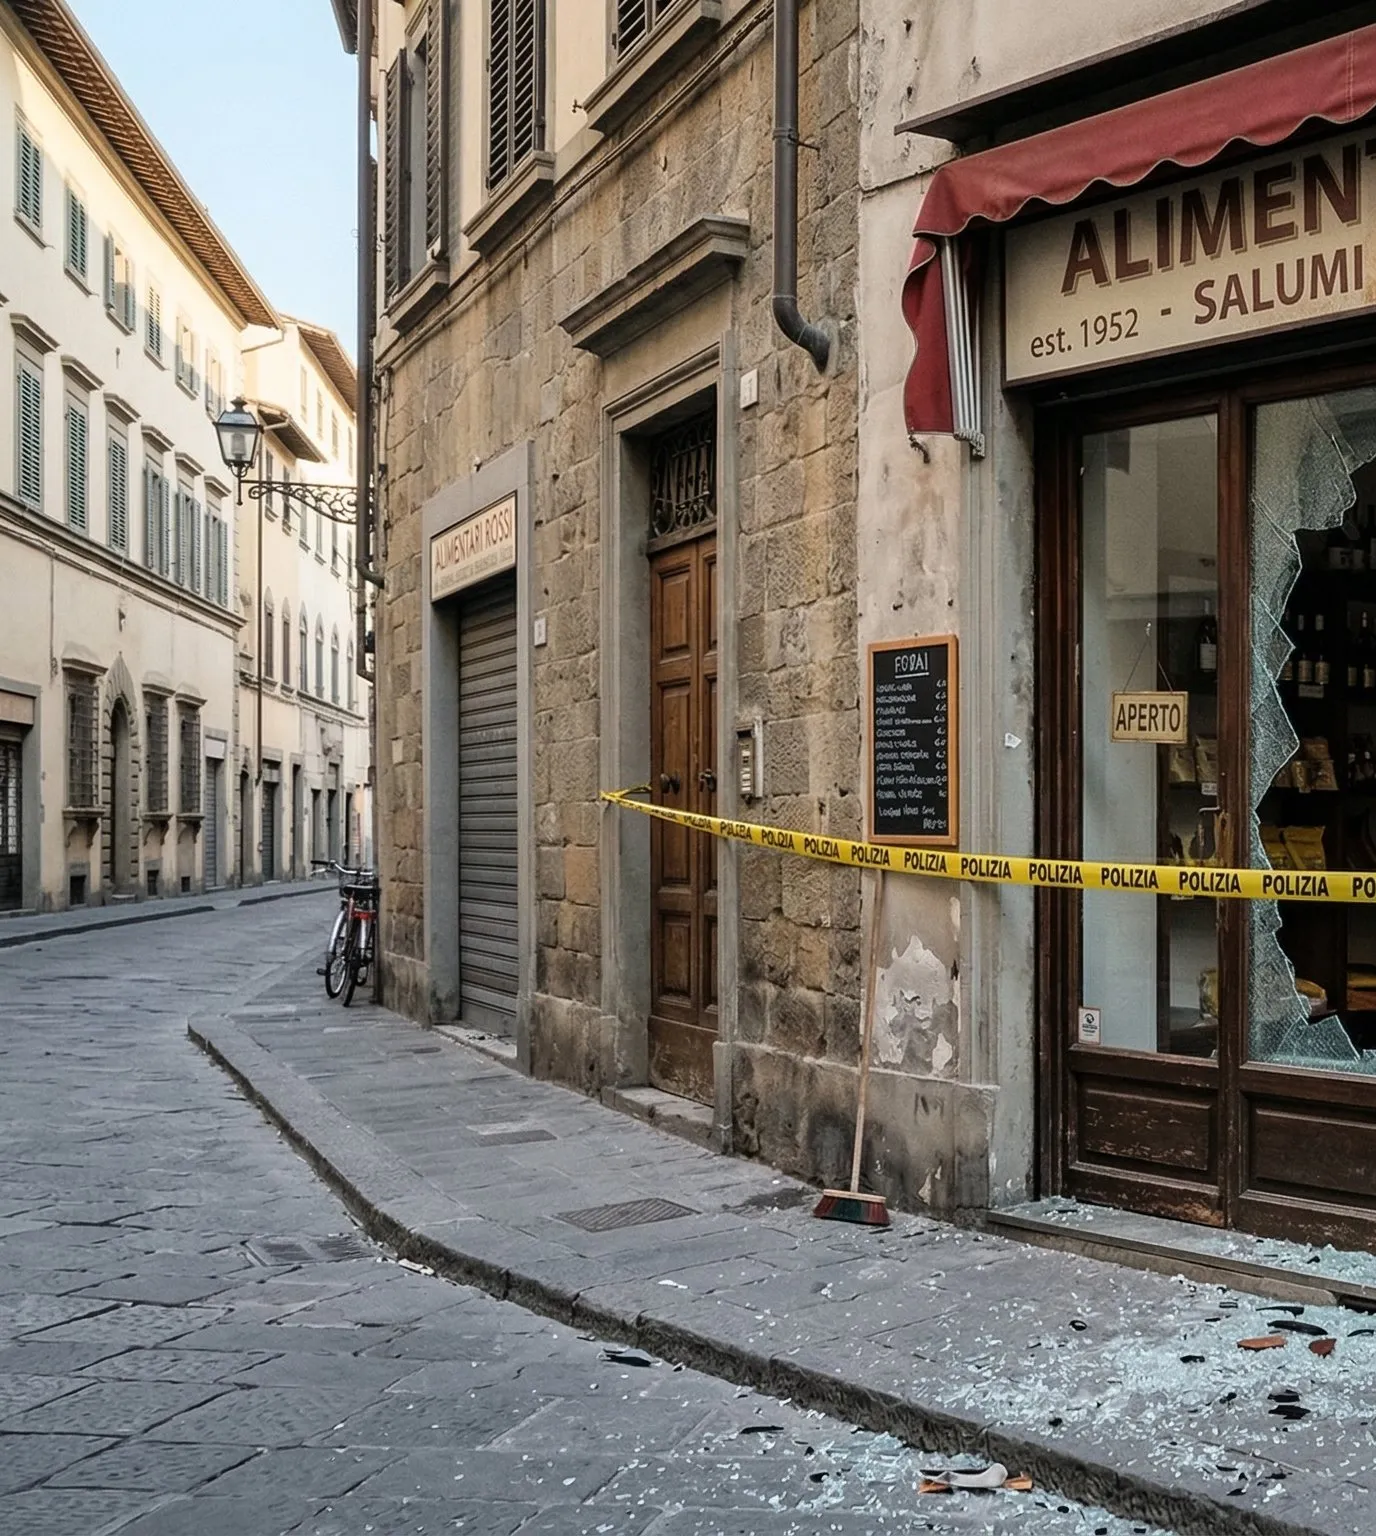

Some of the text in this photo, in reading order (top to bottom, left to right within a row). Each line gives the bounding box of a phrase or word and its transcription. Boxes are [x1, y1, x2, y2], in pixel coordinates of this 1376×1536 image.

[1030, 327, 1073, 358] est.
[1080, 308, 1139, 350] 1952
[1194, 245, 1364, 325] SALUMI
[485, 505, 513, 549] ROSSI
[1115, 703, 1181, 732] APERTO
[804, 837, 840, 858] POLIZIA
[851, 845, 890, 866] POLIZIA
[904, 851, 947, 873] POLIZIA
[961, 858, 1012, 879] POLIZIA
[1029, 863, 1083, 884] POLIZIA
[1101, 867, 1159, 889] POLIZIA
[1179, 871, 1241, 893] POLIZIA
[1262, 875, 1329, 897] POLIZIA
